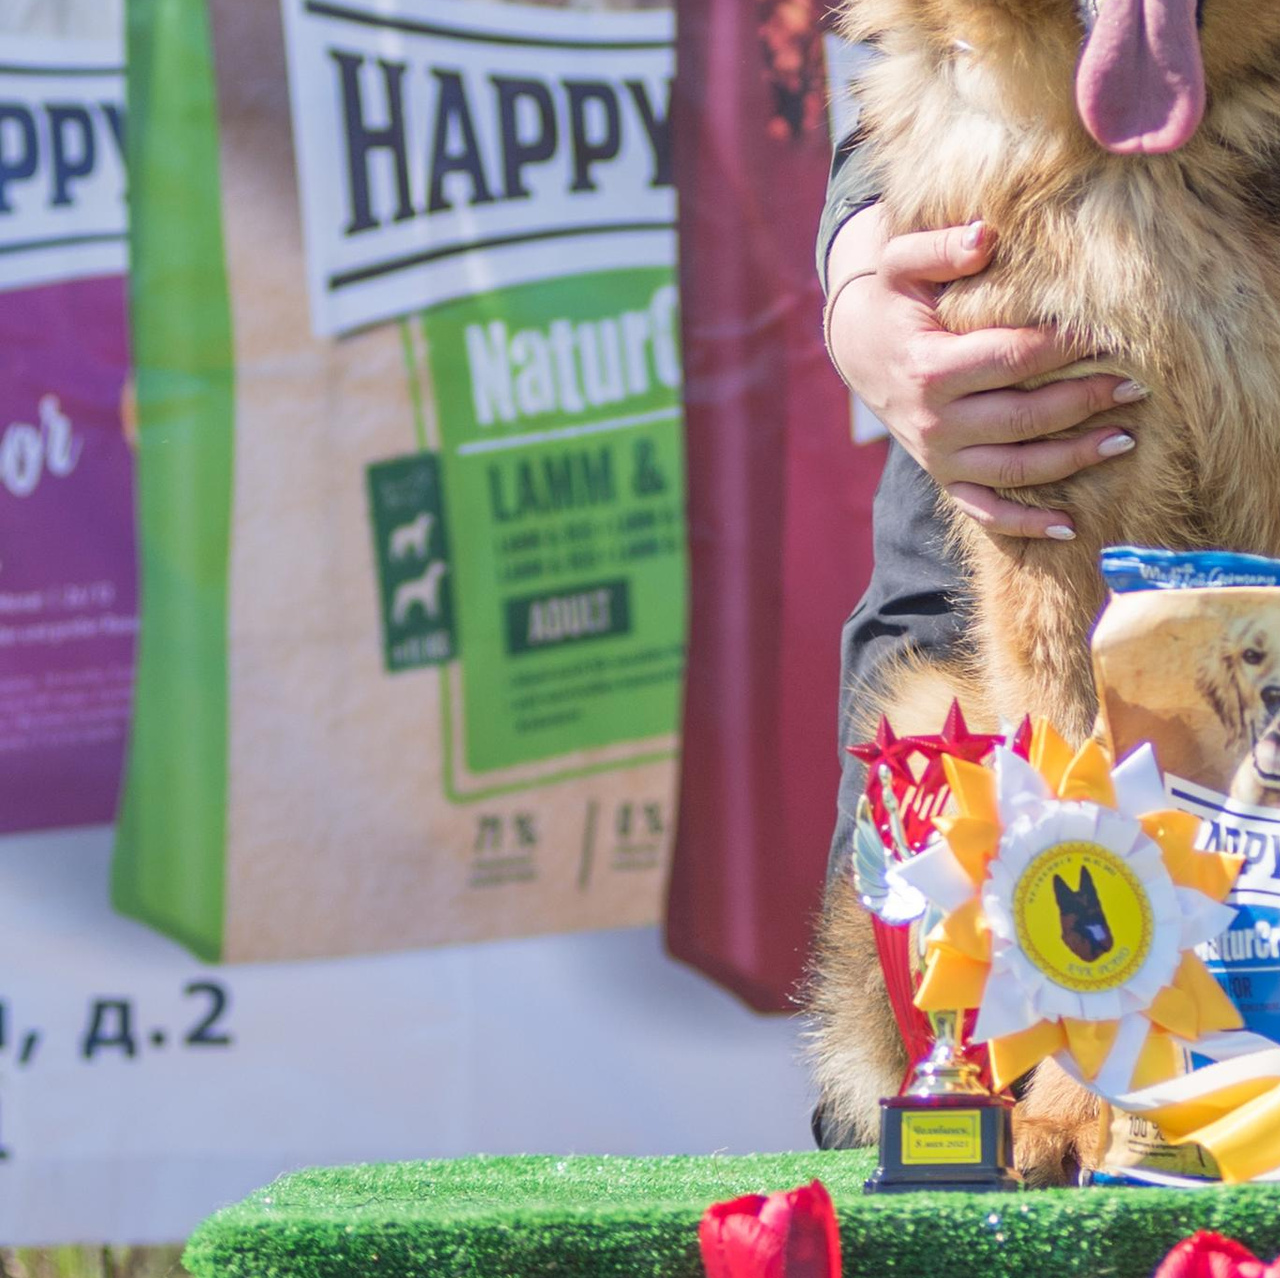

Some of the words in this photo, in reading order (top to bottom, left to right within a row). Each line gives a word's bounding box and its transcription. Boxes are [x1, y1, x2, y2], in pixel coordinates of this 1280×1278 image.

[327, 48, 677, 236] HAPPY
[487, 445, 617, 524] LAMM
[81, 981, 234, 1062] д.2
